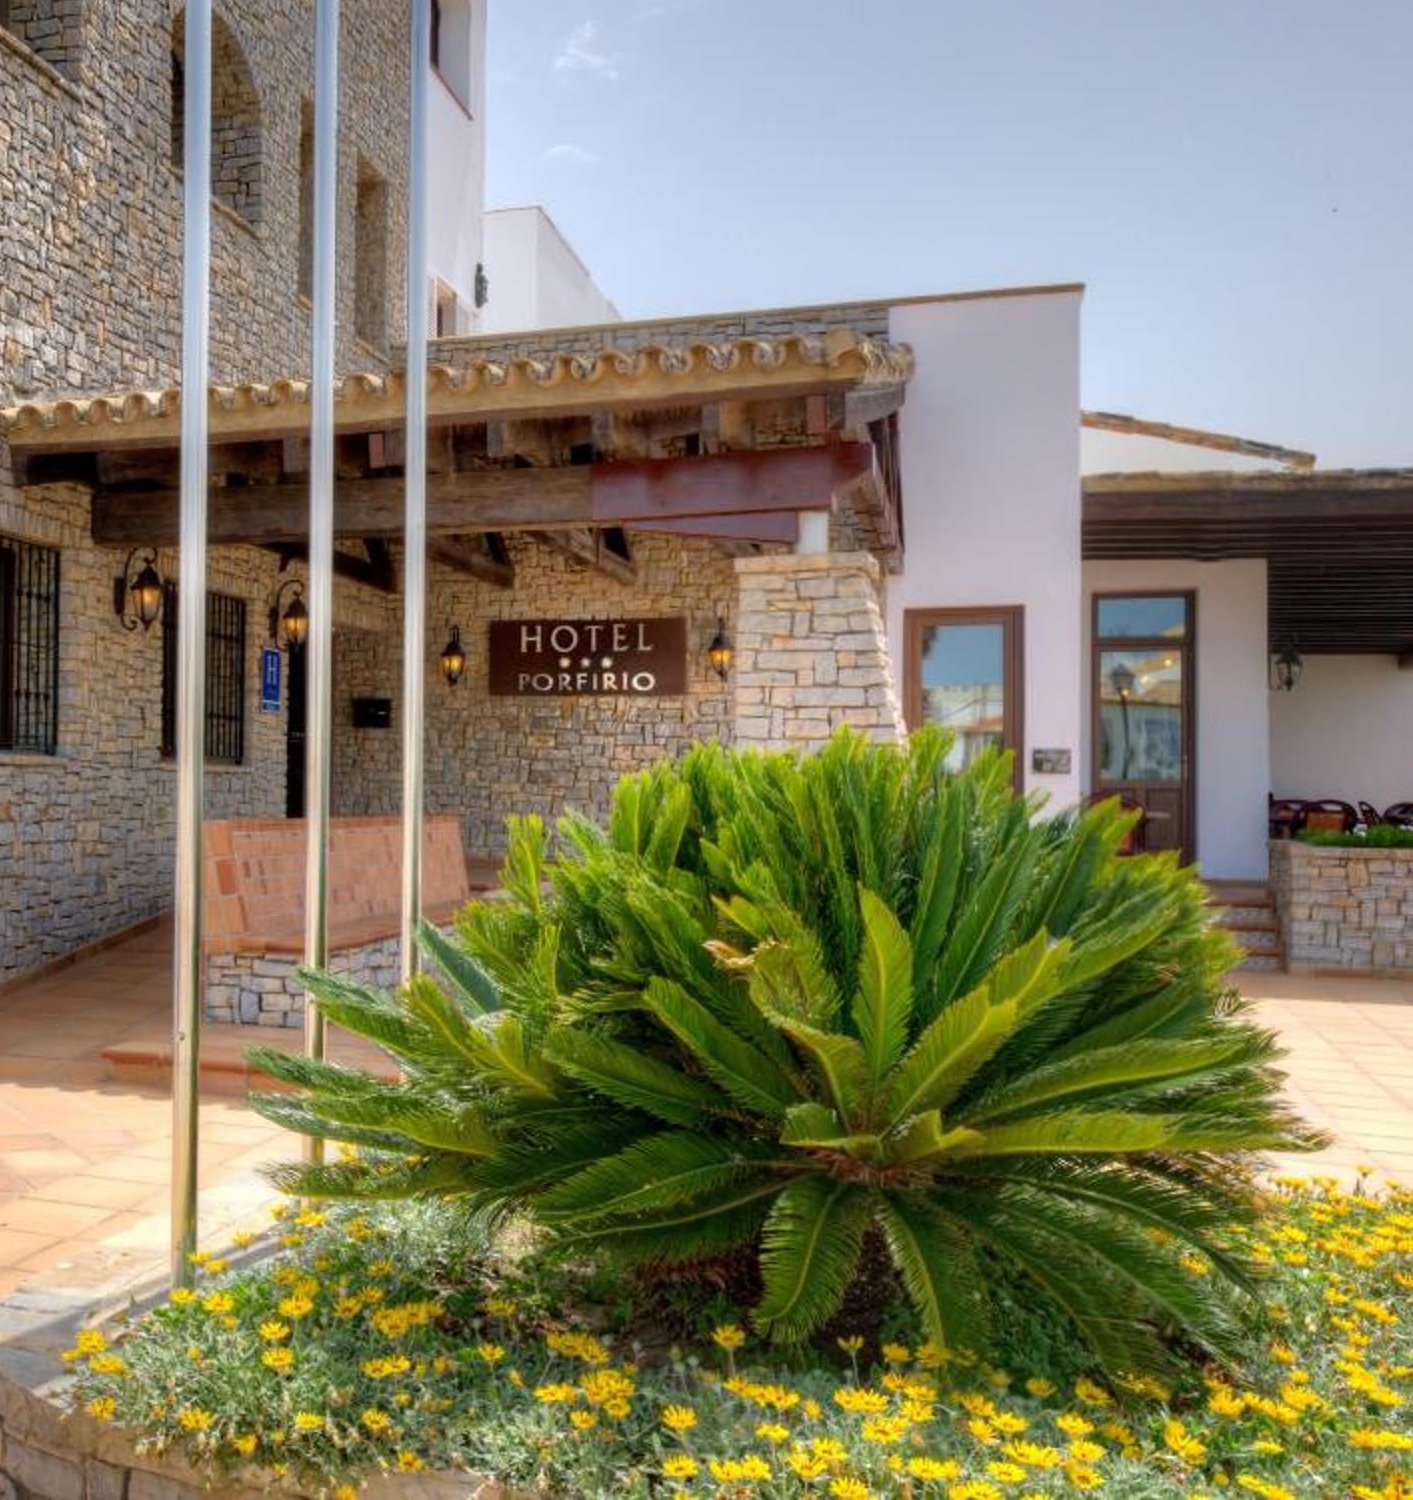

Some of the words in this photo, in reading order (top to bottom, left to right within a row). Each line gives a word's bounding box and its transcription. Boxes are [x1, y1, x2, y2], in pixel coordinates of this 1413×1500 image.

[520, 623, 655, 653] HOTEL
[266, 654, 279, 685] H
[518, 671, 656, 692] PORFIRIO
